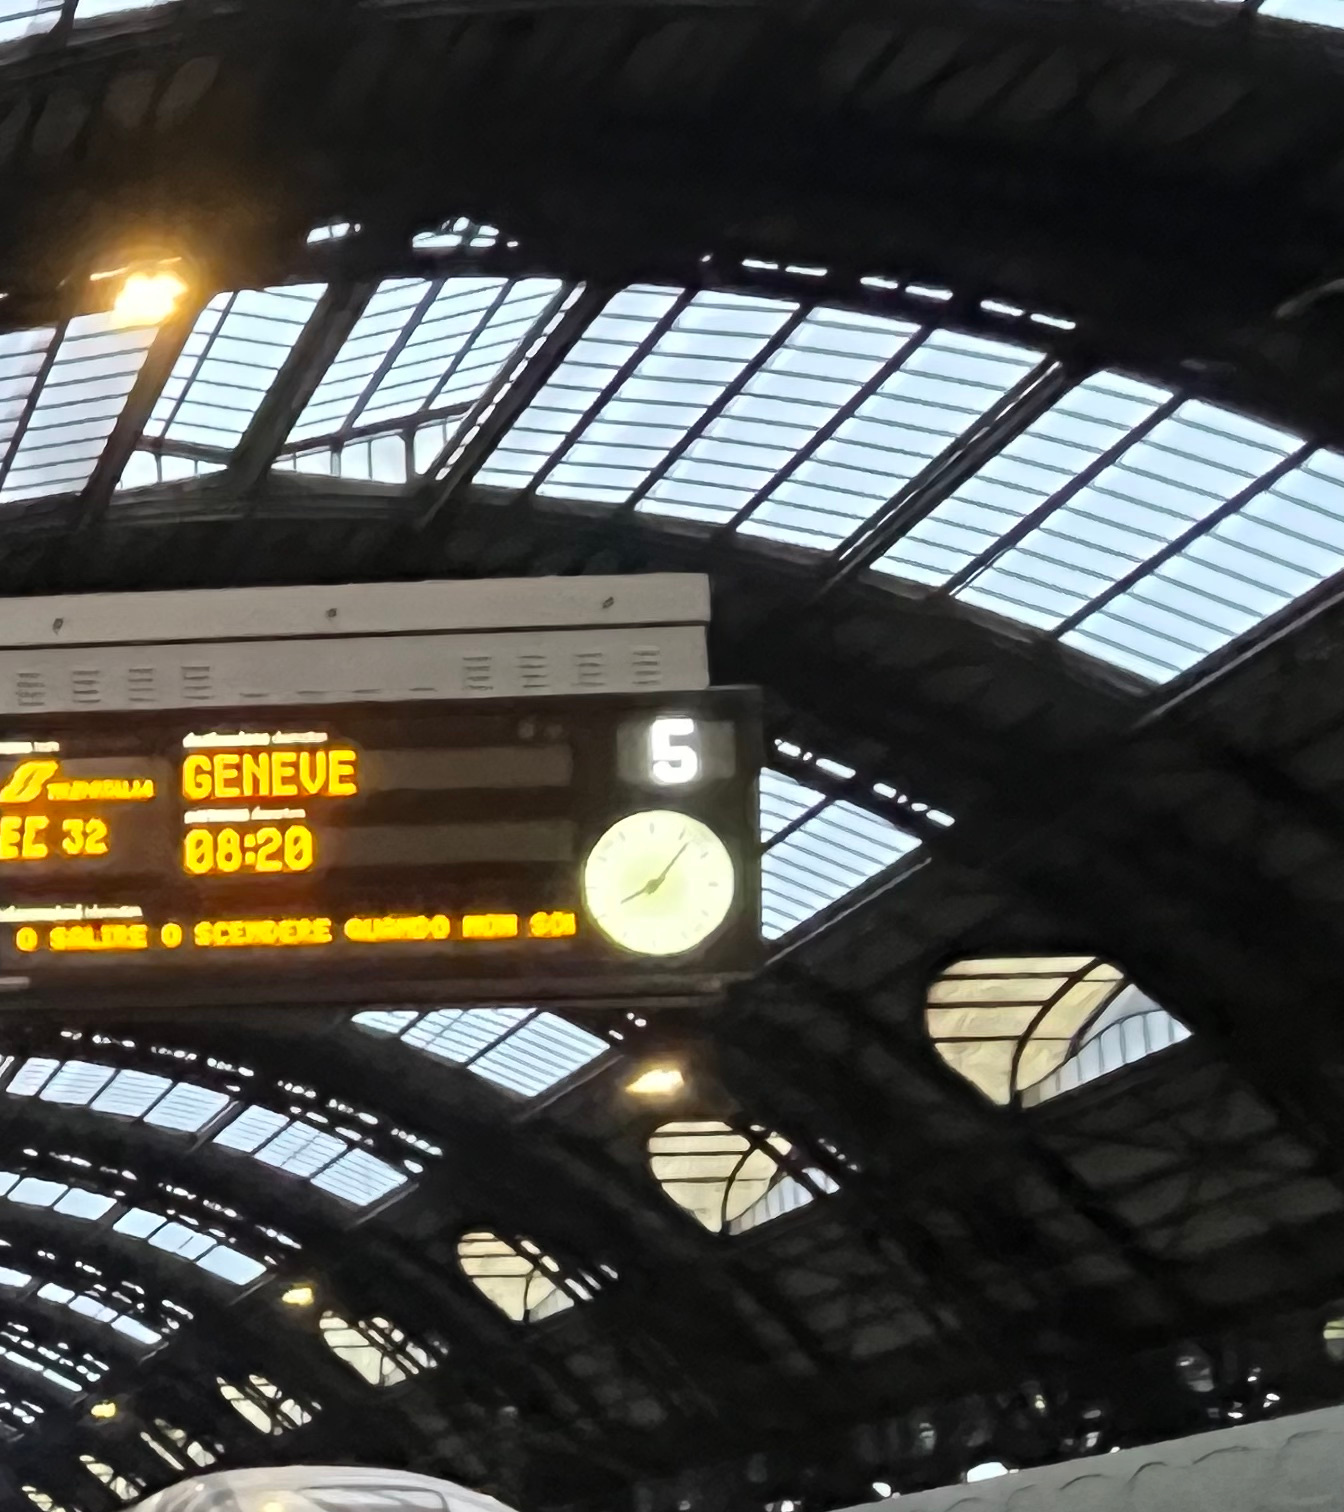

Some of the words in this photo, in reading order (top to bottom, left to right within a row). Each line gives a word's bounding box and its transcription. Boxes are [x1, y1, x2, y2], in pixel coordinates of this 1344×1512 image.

[183, 750, 357, 799] GENEVE
[648, 719, 698, 785] 5
[62, 817, 108, 854] 32
[184, 825, 313, 874] 08:20
